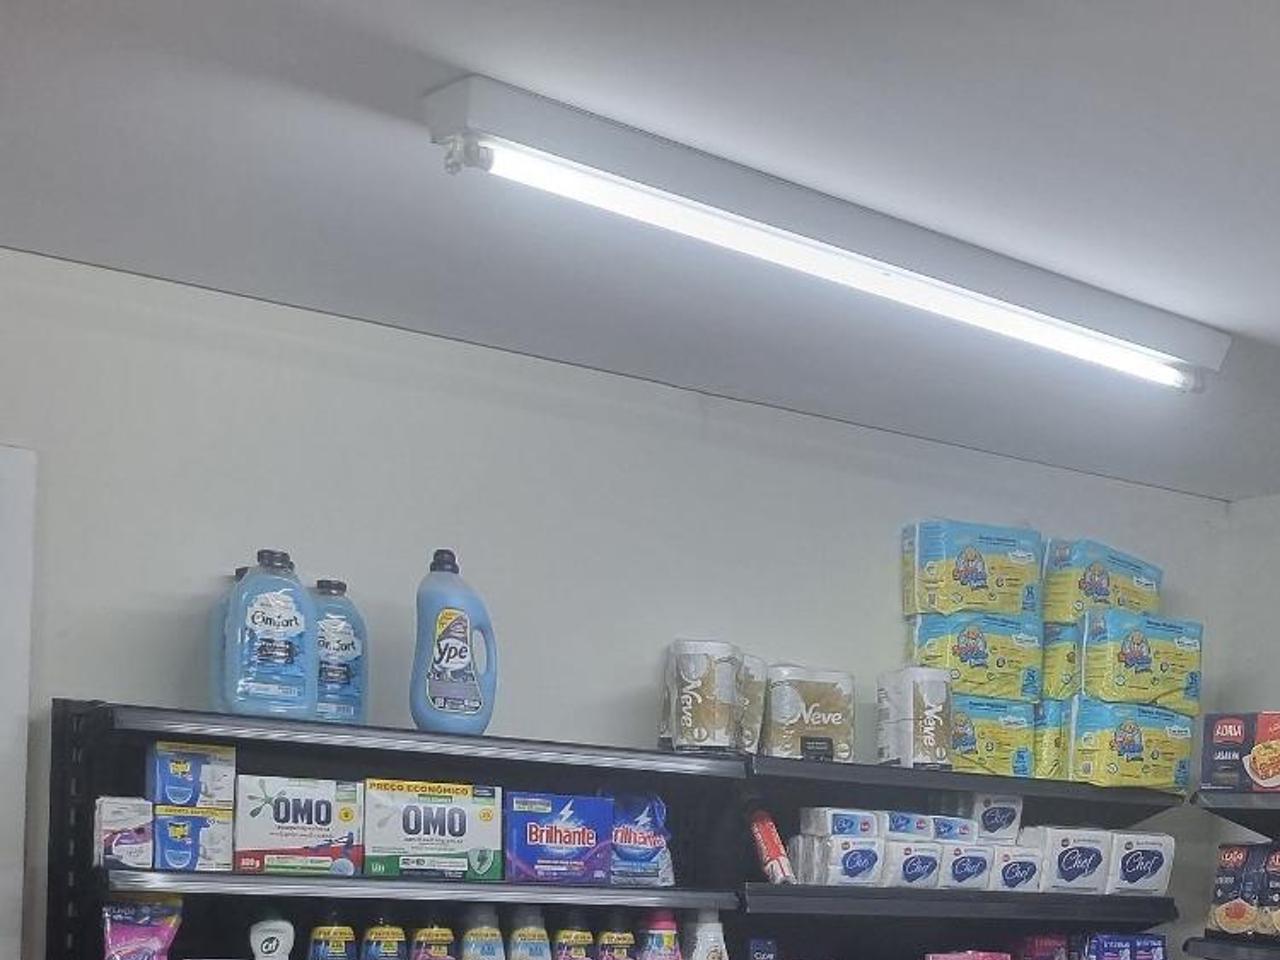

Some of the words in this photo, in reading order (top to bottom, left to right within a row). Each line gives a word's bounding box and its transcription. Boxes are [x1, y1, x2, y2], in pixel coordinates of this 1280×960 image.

[317, 635, 356, 653] omfort
[797, 703, 843, 726] Neve
[272, 797, 332, 826] OMO
[401, 804, 468, 837] OMO
[527, 822, 597, 848] Brilhante
[954, 855, 983, 873] Chef
[1060, 847, 1094, 872] Chef
[1124, 850, 1157, 873] Chef
